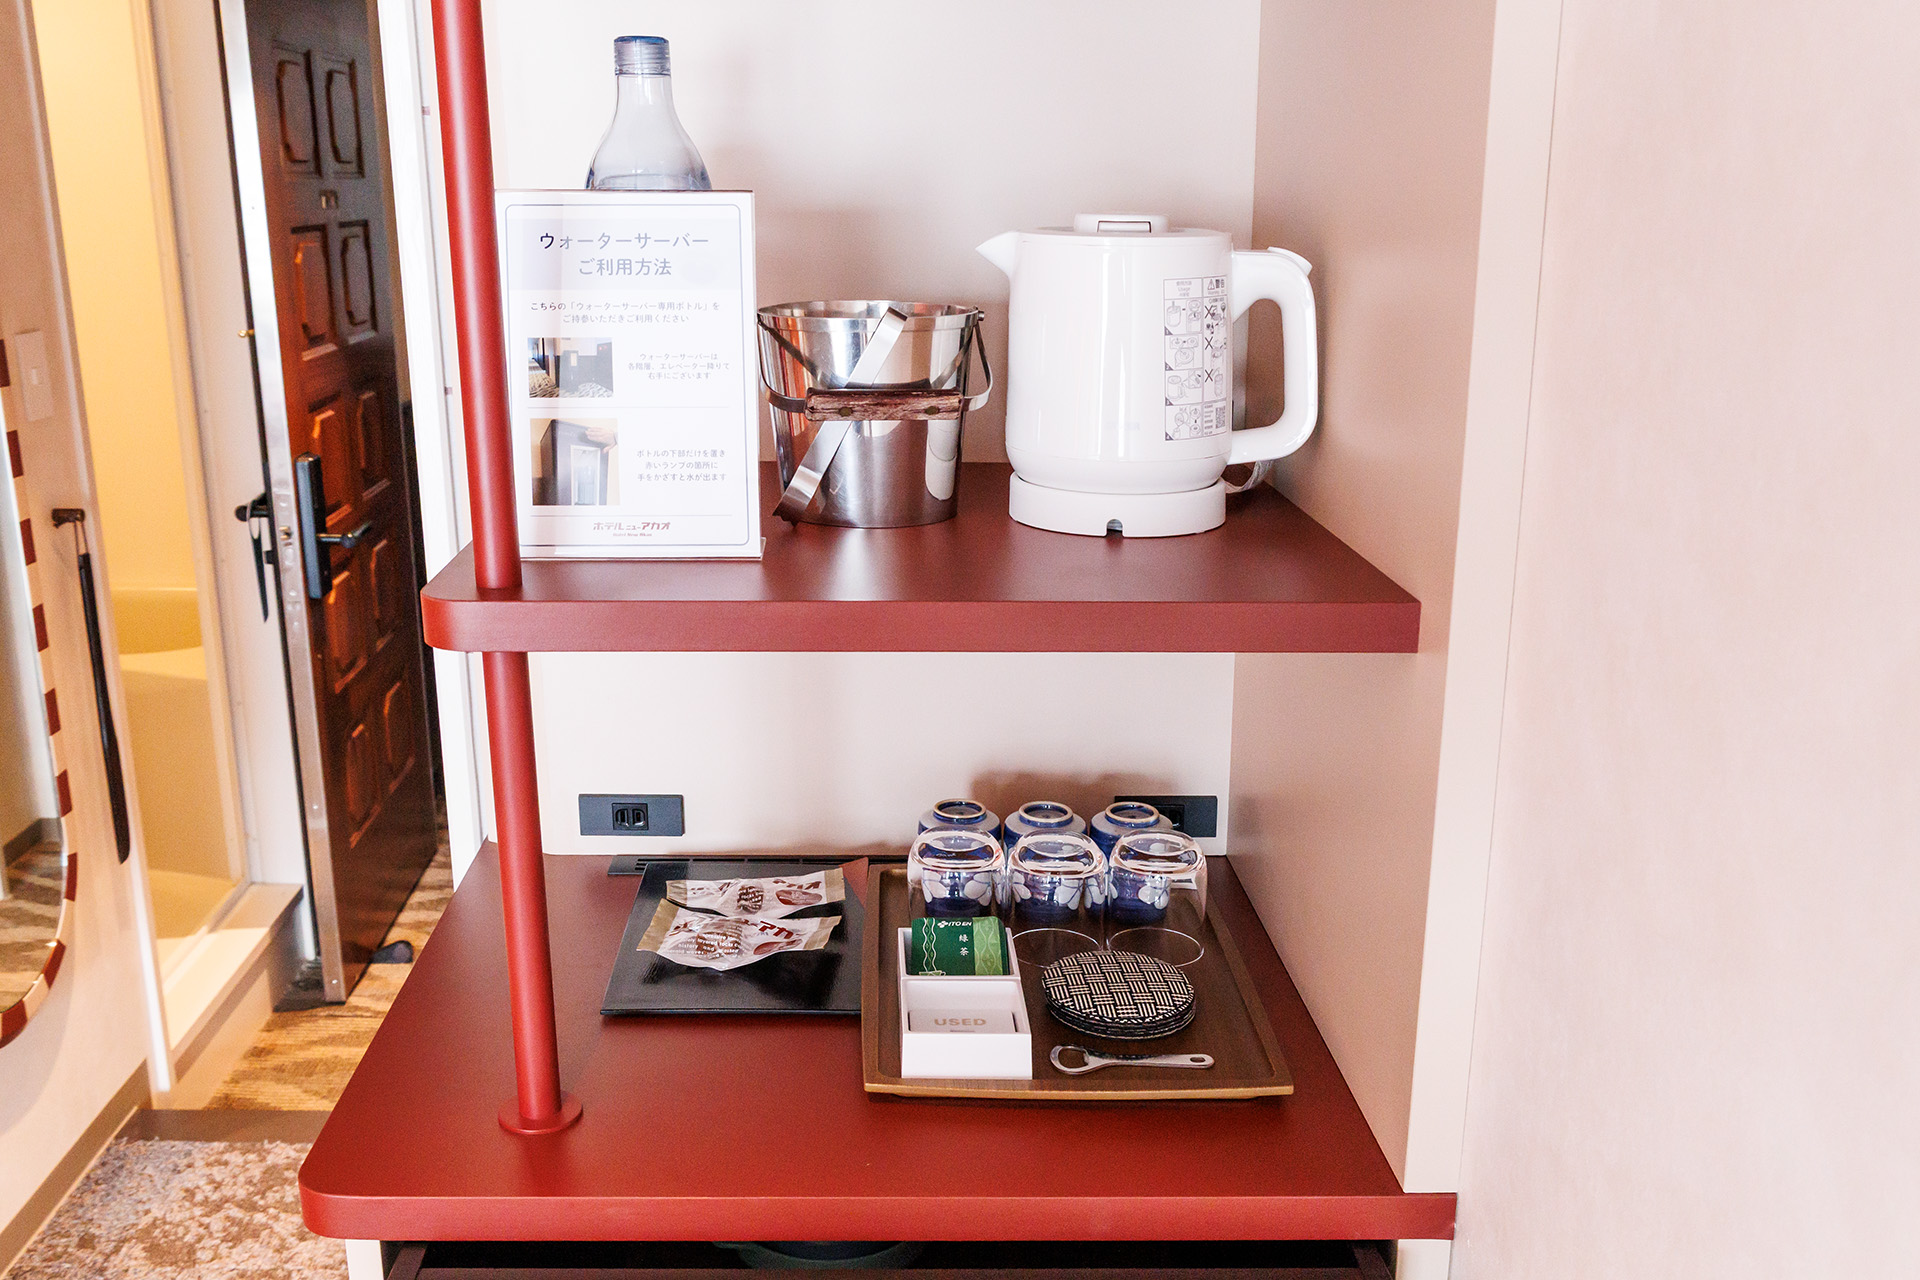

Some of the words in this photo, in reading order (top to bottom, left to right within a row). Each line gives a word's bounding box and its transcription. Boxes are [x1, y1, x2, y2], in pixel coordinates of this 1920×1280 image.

[540, 232, 709, 249] ウォーターサーバー
[579, 257, 672, 276] ご利用方法
[530, 302, 720, 311] こちらの「ウォーターサーバー専用ボトル」を
[562, 314, 689, 324] ご持参いただきご利用ください
[637, 473, 727, 482] 手をかざすと水が出ます
[934, 1018, 986, 1026] USED
